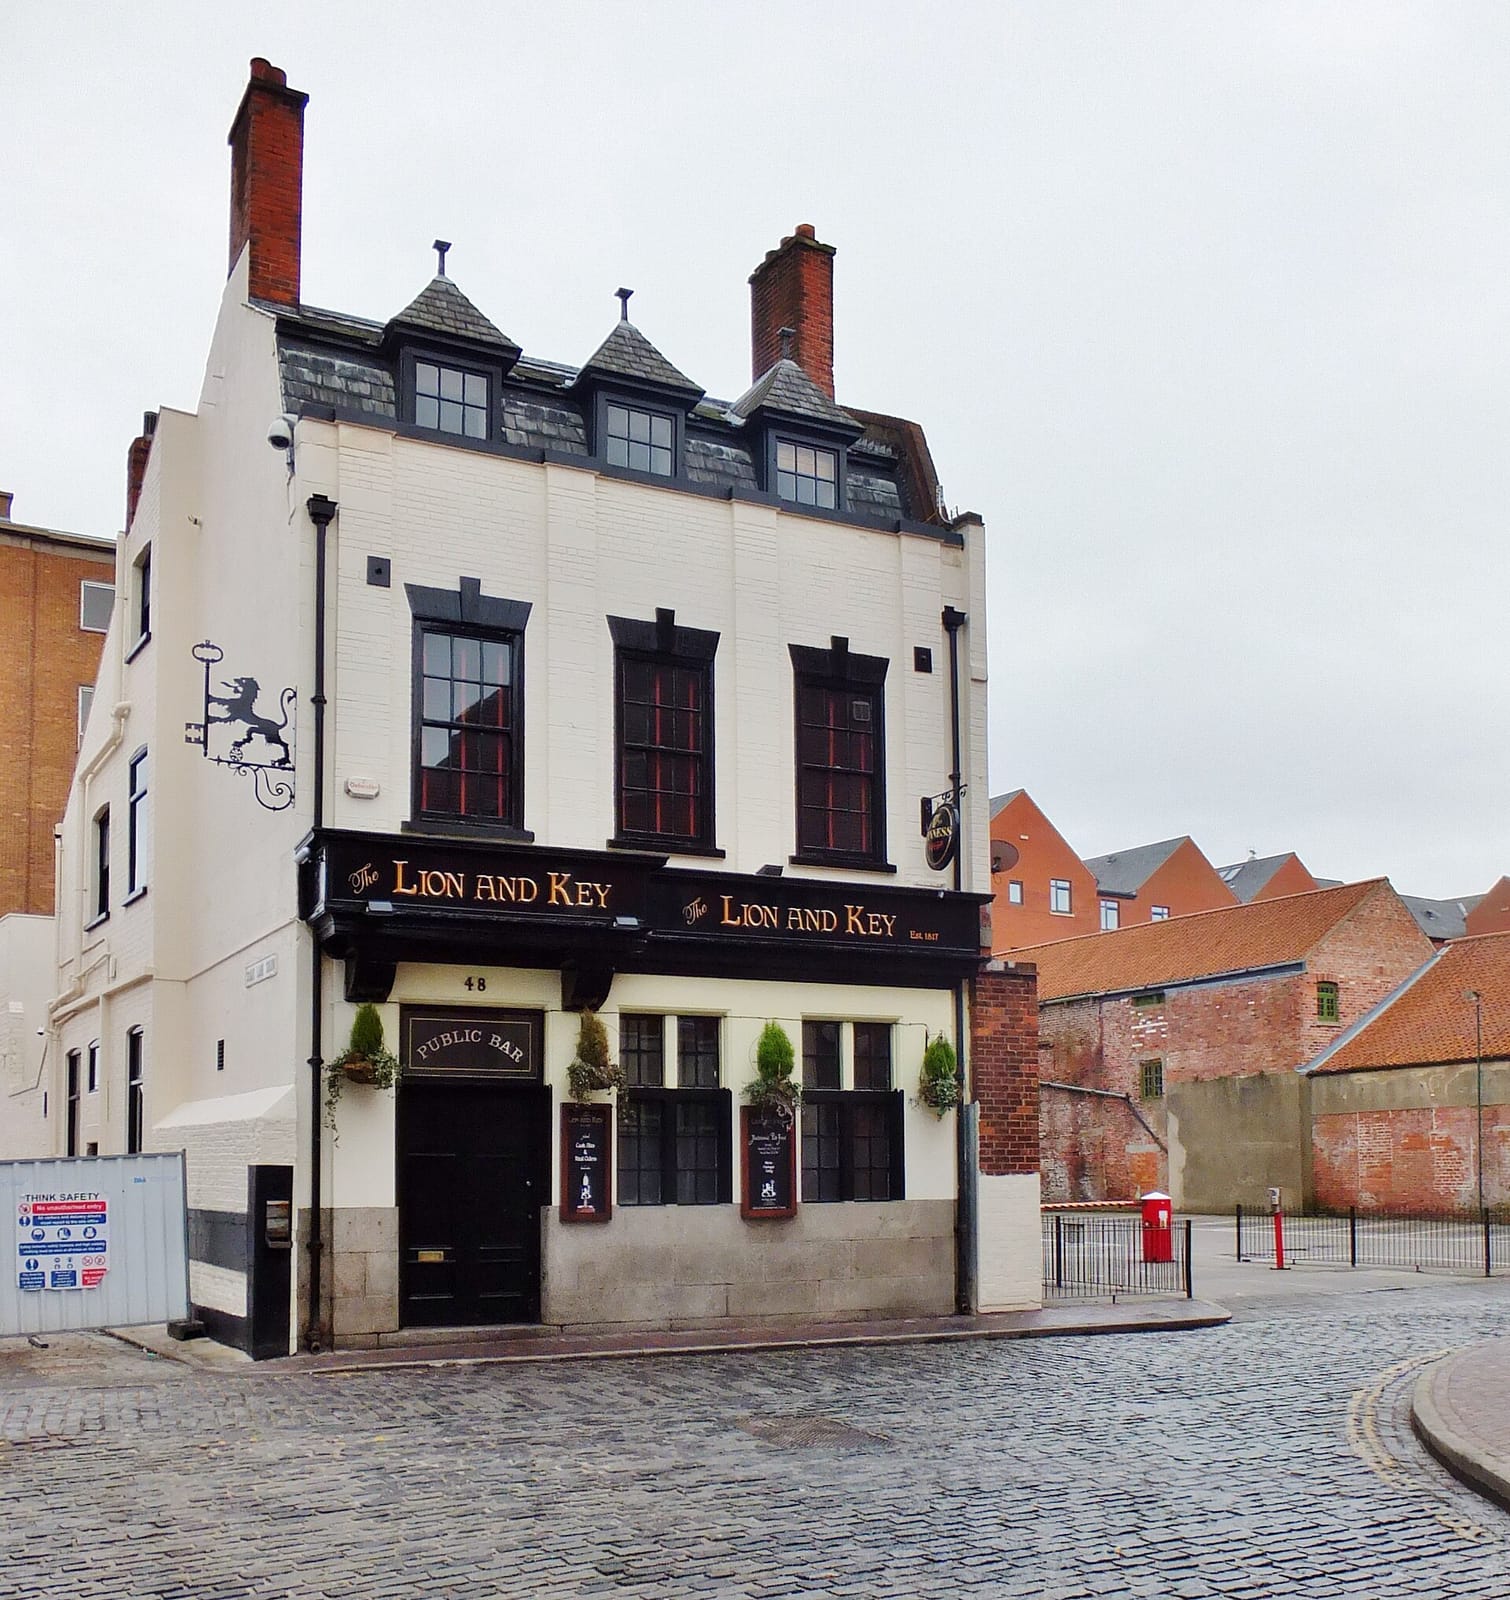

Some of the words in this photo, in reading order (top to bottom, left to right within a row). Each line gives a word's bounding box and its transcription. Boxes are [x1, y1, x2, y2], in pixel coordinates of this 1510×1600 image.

[348, 863, 379, 894] The
[392, 860, 465, 898] LION
[473, 874, 539, 903] AND
[546, 871, 613, 908] KEY
[682, 896, 708, 925] The
[719, 895, 780, 928] LION
[785, 907, 838, 932] AND
[843, 904, 897, 937] KEY
[464, 976, 487, 991] 48
[416, 1029, 482, 1060] PUBLIC
[487, 1033, 524, 1063] BAR
[25, 1193, 56, 1202] THINK
[60, 1193, 99, 1201] SAFETY
